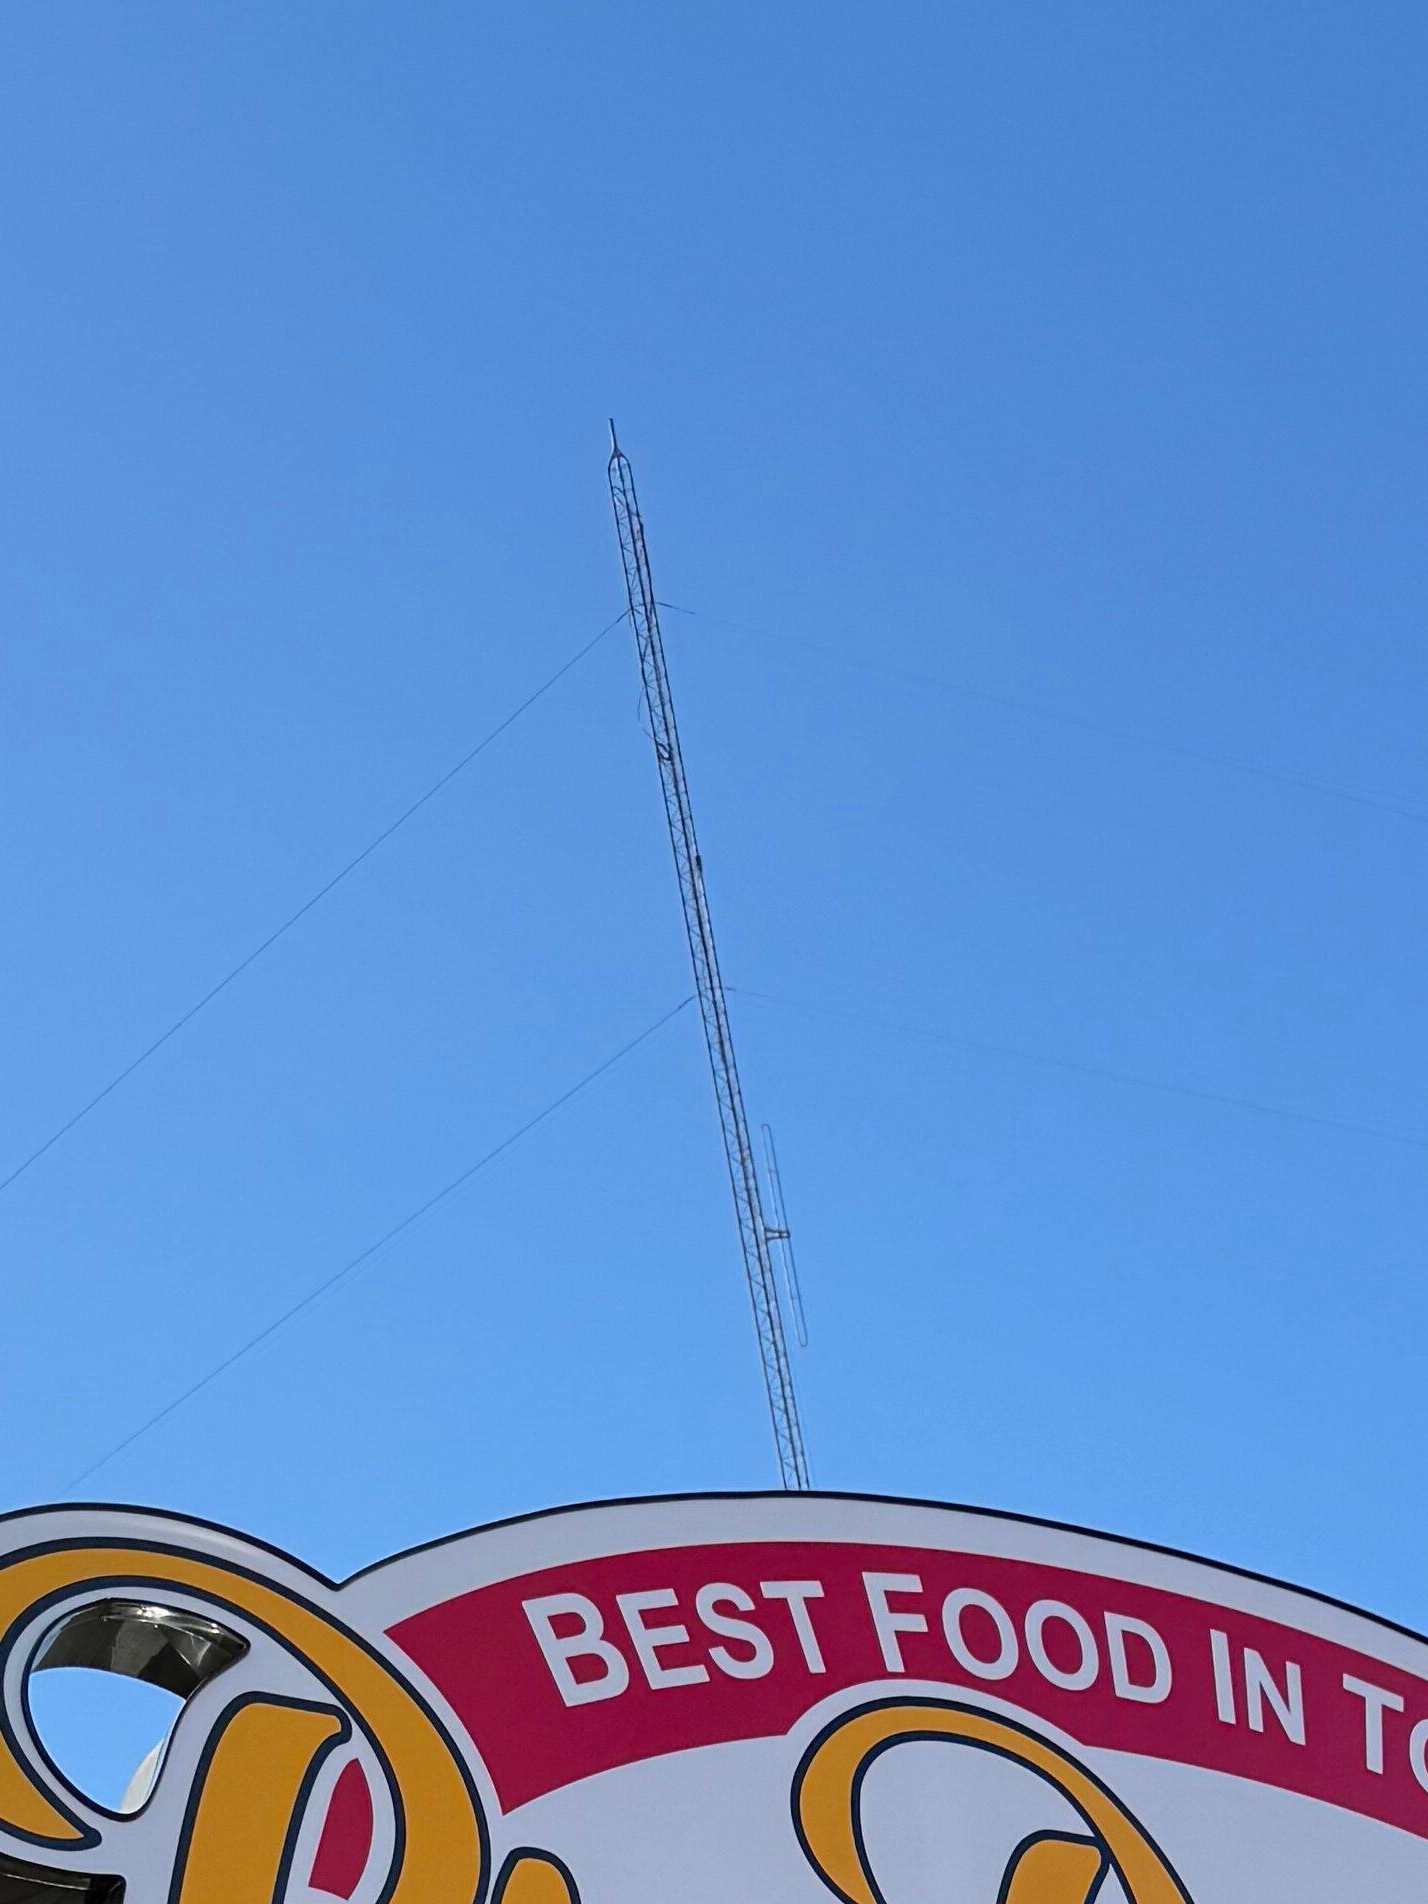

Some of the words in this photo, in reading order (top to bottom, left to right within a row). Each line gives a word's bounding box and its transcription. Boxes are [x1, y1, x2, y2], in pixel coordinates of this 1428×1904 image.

[522, 1580, 824, 1706] BEST
[861, 1571, 1172, 1704] FOOD
[1210, 1628, 1305, 1746] IN
